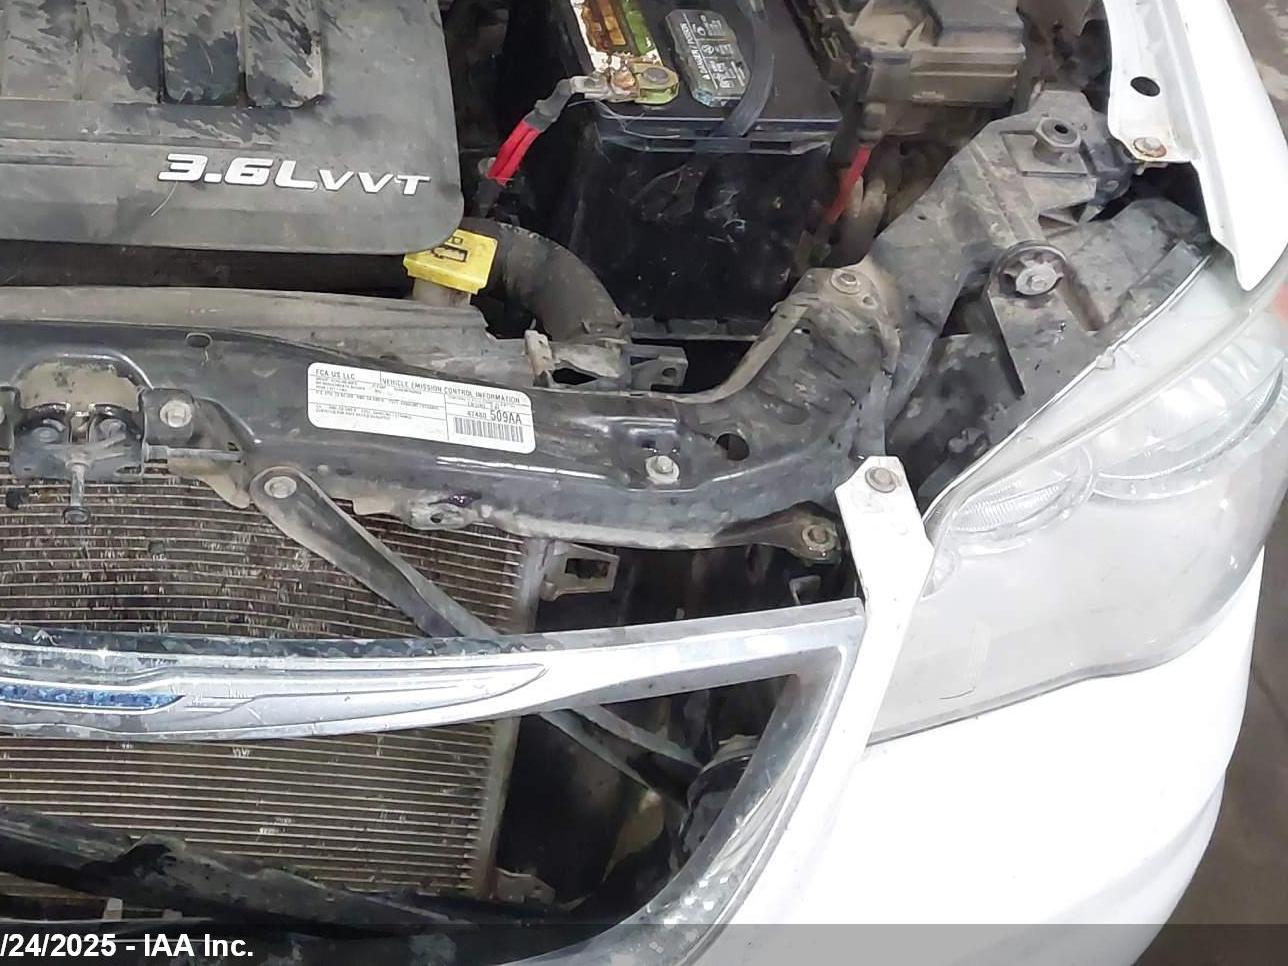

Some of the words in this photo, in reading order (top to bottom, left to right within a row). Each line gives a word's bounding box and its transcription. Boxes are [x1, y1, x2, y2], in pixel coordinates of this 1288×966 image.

[315, 369, 329, 377] FCA
[343, 372, 356, 380] LLC
[382, 378, 410, 387] VEHICLE
[411, 381, 442, 392] EMISSION
[444, 386, 473, 396] CONTROL
[475, 391, 520, 403] INFORMATION
[490, 409, 522, 424] 509AA
